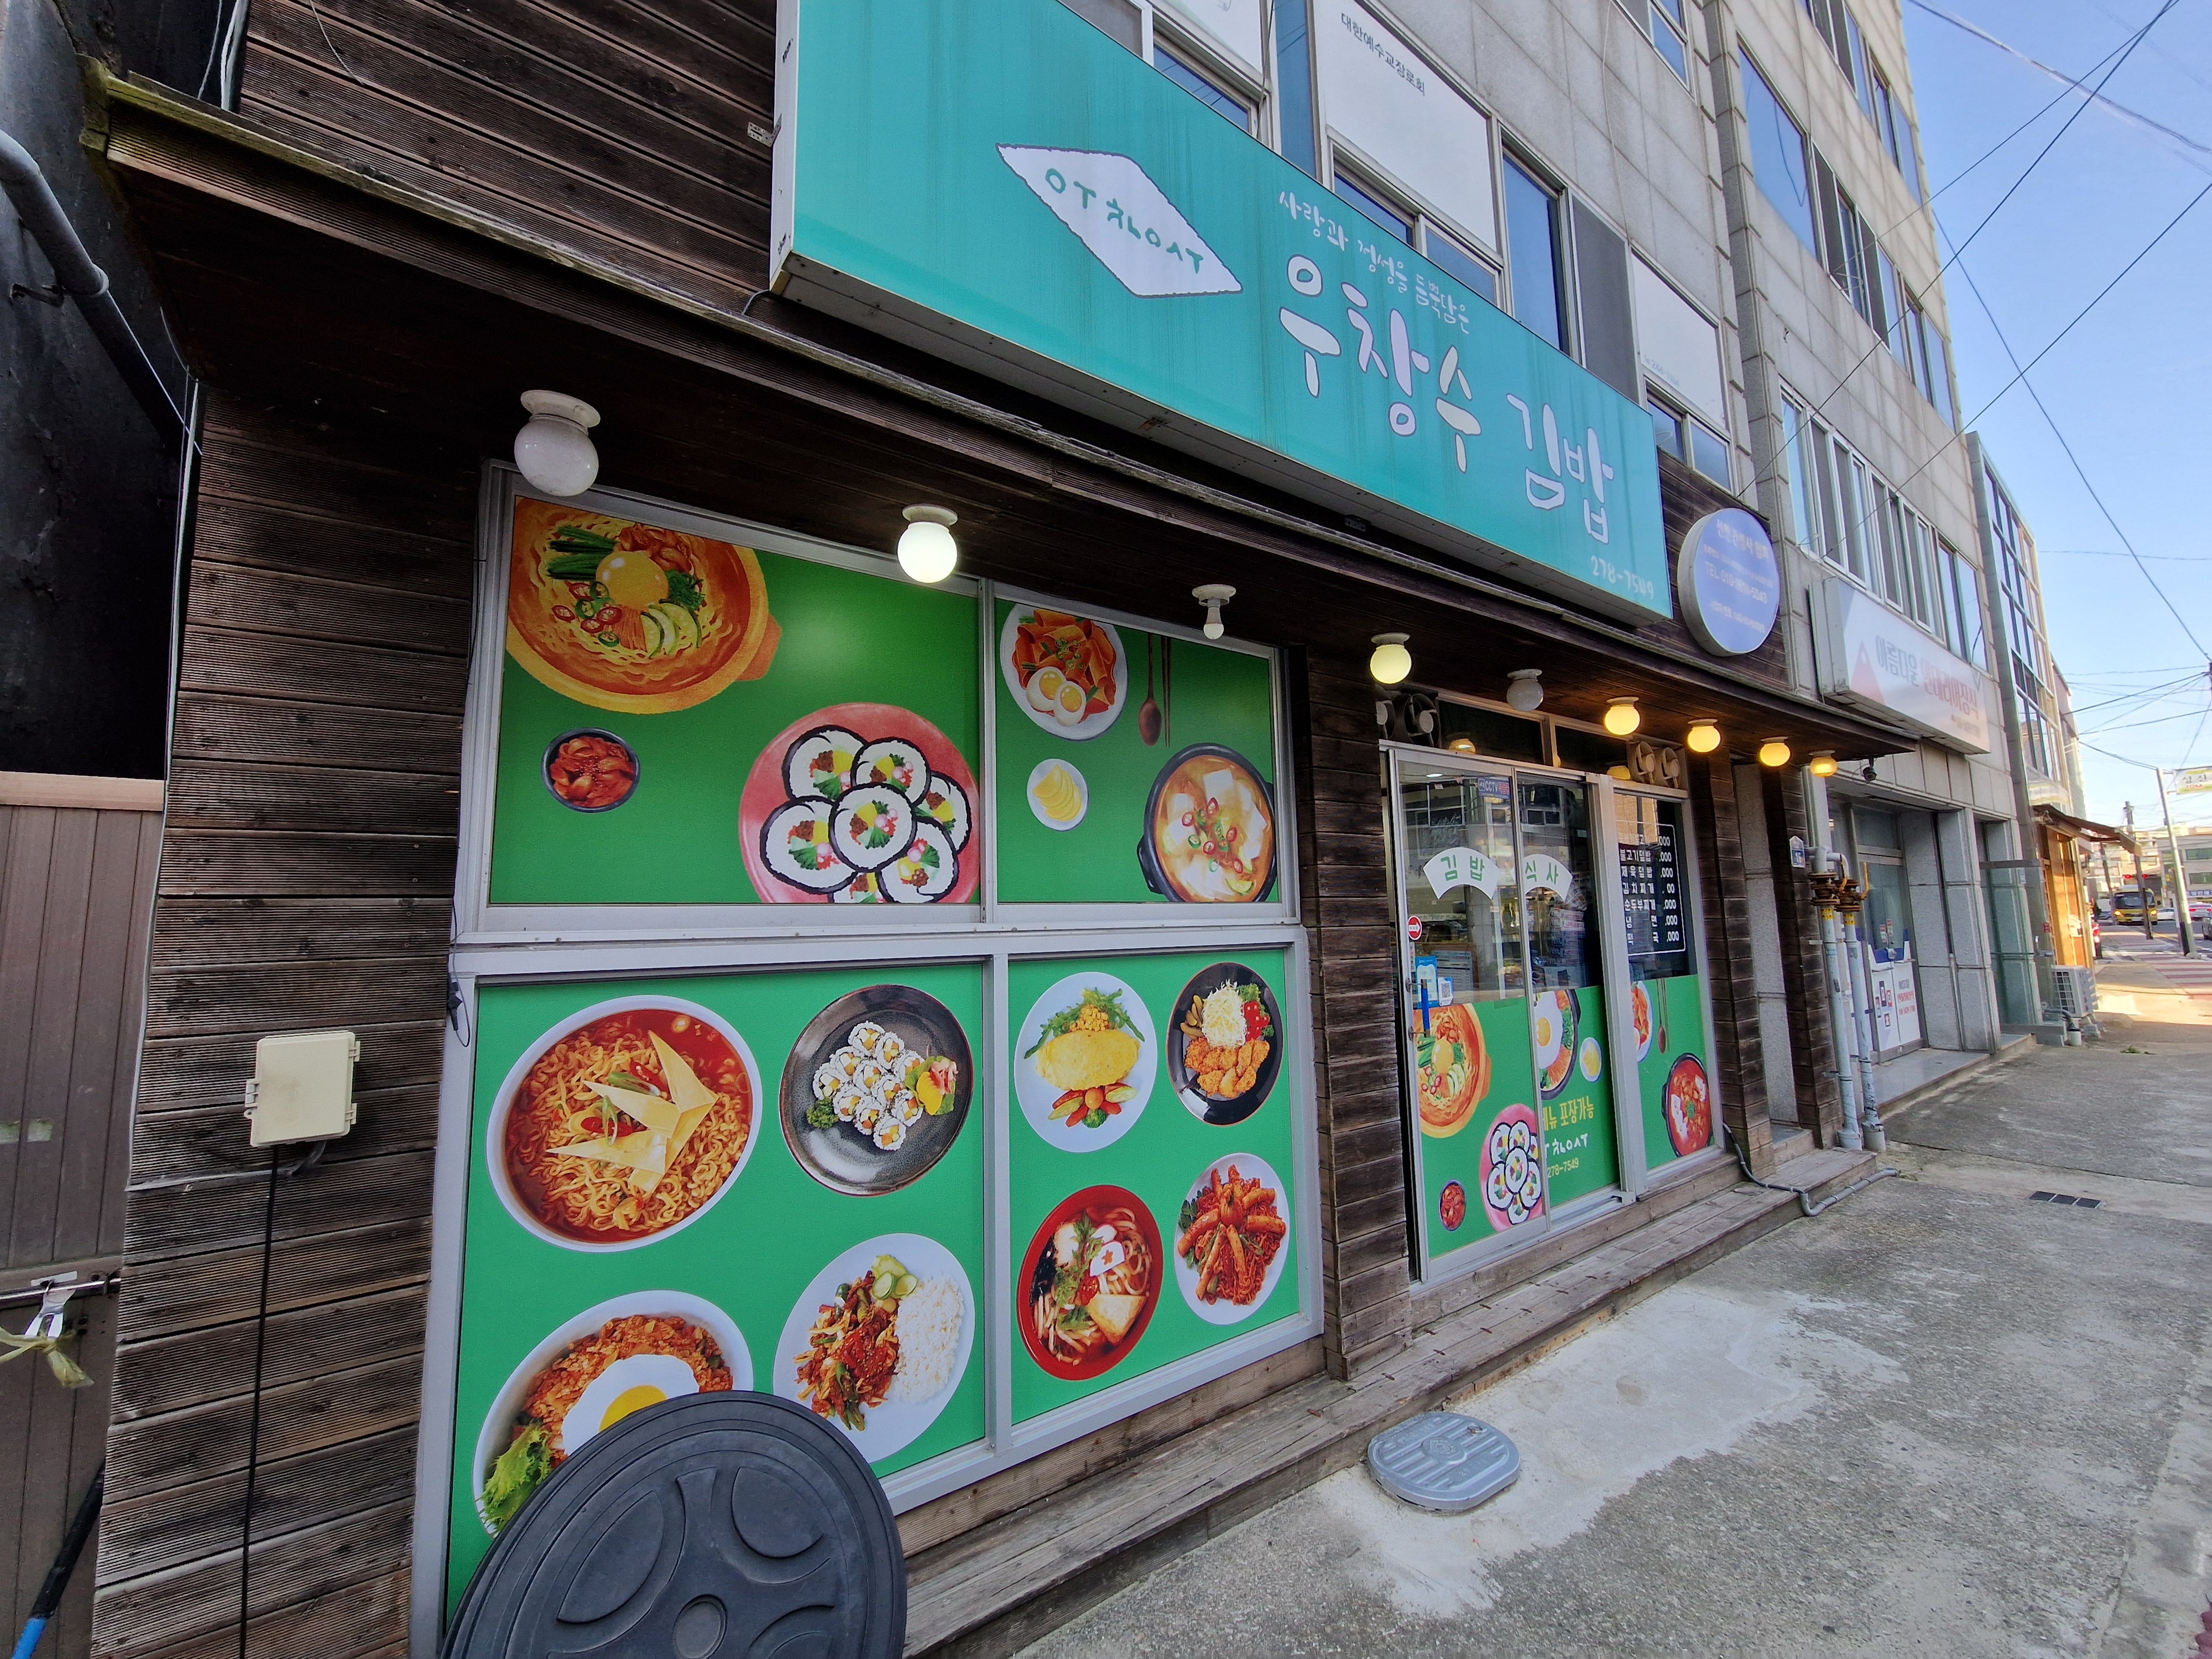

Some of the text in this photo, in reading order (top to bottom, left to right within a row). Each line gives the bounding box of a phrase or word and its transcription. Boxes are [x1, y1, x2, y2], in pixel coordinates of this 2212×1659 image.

[1341, 13, 1425, 97] 대한예수교장로회
[1279, 191, 1470, 335] 사랑과 정성을 듬뿍담은
[1279, 254, 1614, 544] 우창수 김밥
[1591, 555, 1654, 601] 278-7549
[1705, 561, 1719, 580] TEL
[1876, 636, 1919, 687] 아름다운
[1485, 781, 1498, 792] CCTV
[1620, 848, 1651, 862] 불고기덮밥
[1621, 865, 1653, 879] 제육덮밥
[1622, 882, 1655, 895] 김치찌개
[1624, 899, 1656, 912] 순두부찌개
[1559, 1095, 1595, 1127] 포장가능
[1547, 1157, 1579, 1179] 278-7549
